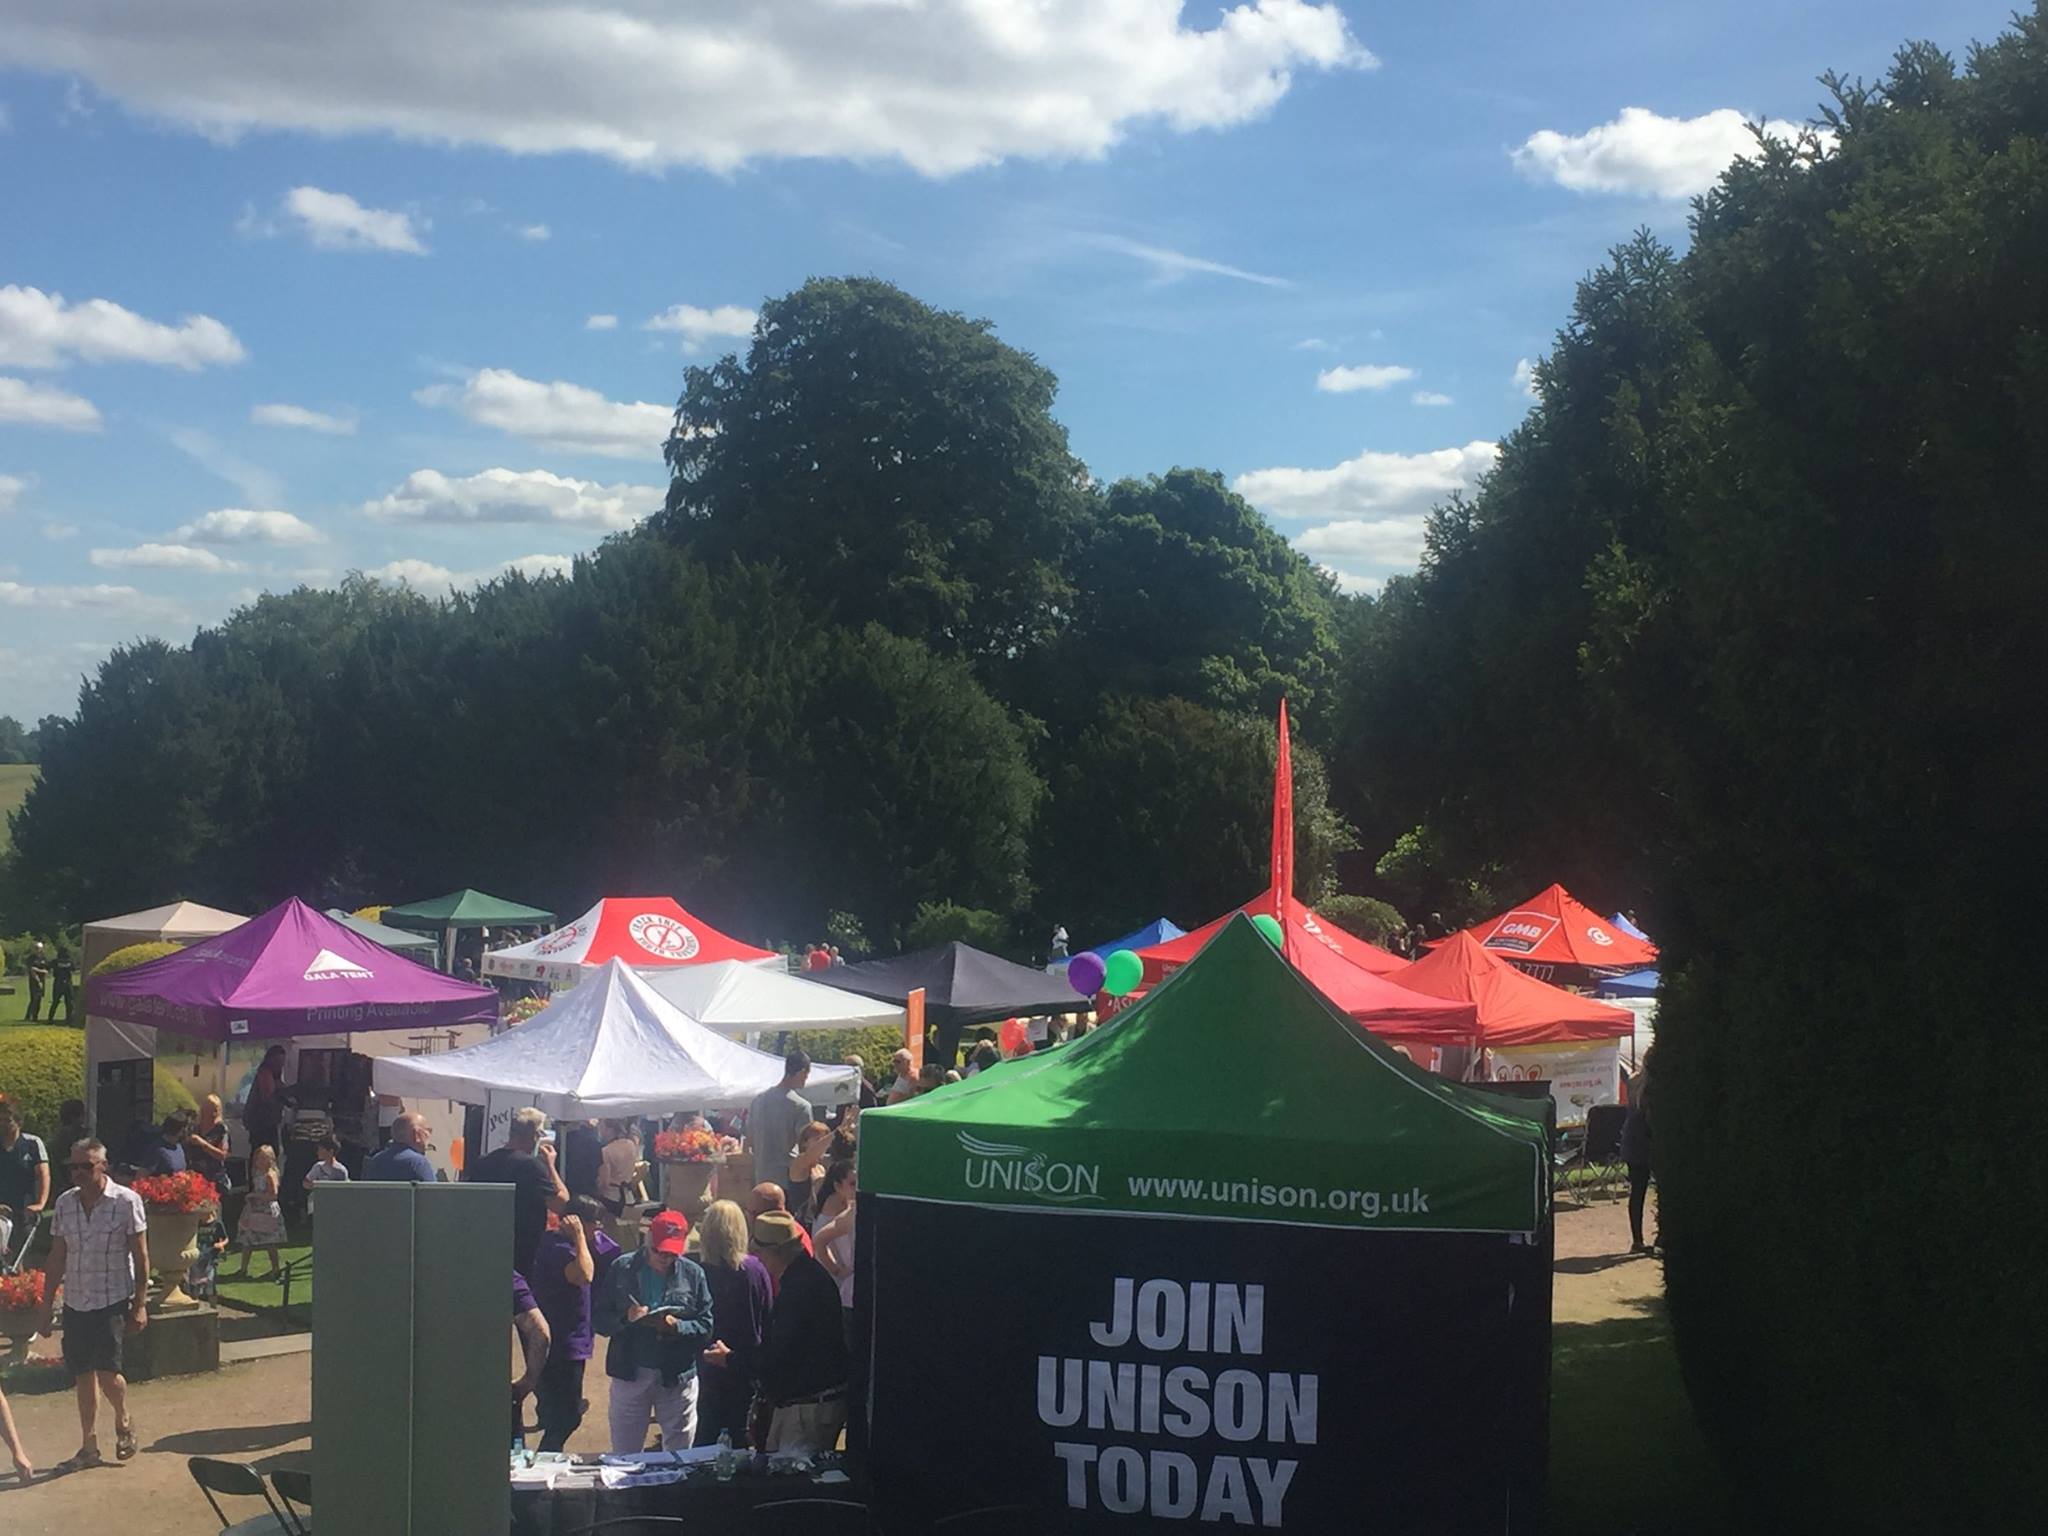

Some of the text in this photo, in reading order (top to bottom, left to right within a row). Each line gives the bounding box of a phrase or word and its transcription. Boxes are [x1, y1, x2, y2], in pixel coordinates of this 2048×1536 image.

[1502, 923, 1542, 938] GMB
[303, 970, 375, 981] GALA TENT
[307, 1004, 363, 1021] Printing
[965, 1157, 1430, 1219] UNISON www.unison.org.uk
[1089, 1277, 1265, 1355] JOIN
[1036, 1355, 1319, 1444] UNISON
[1053, 1441, 1299, 1528] TODAY
